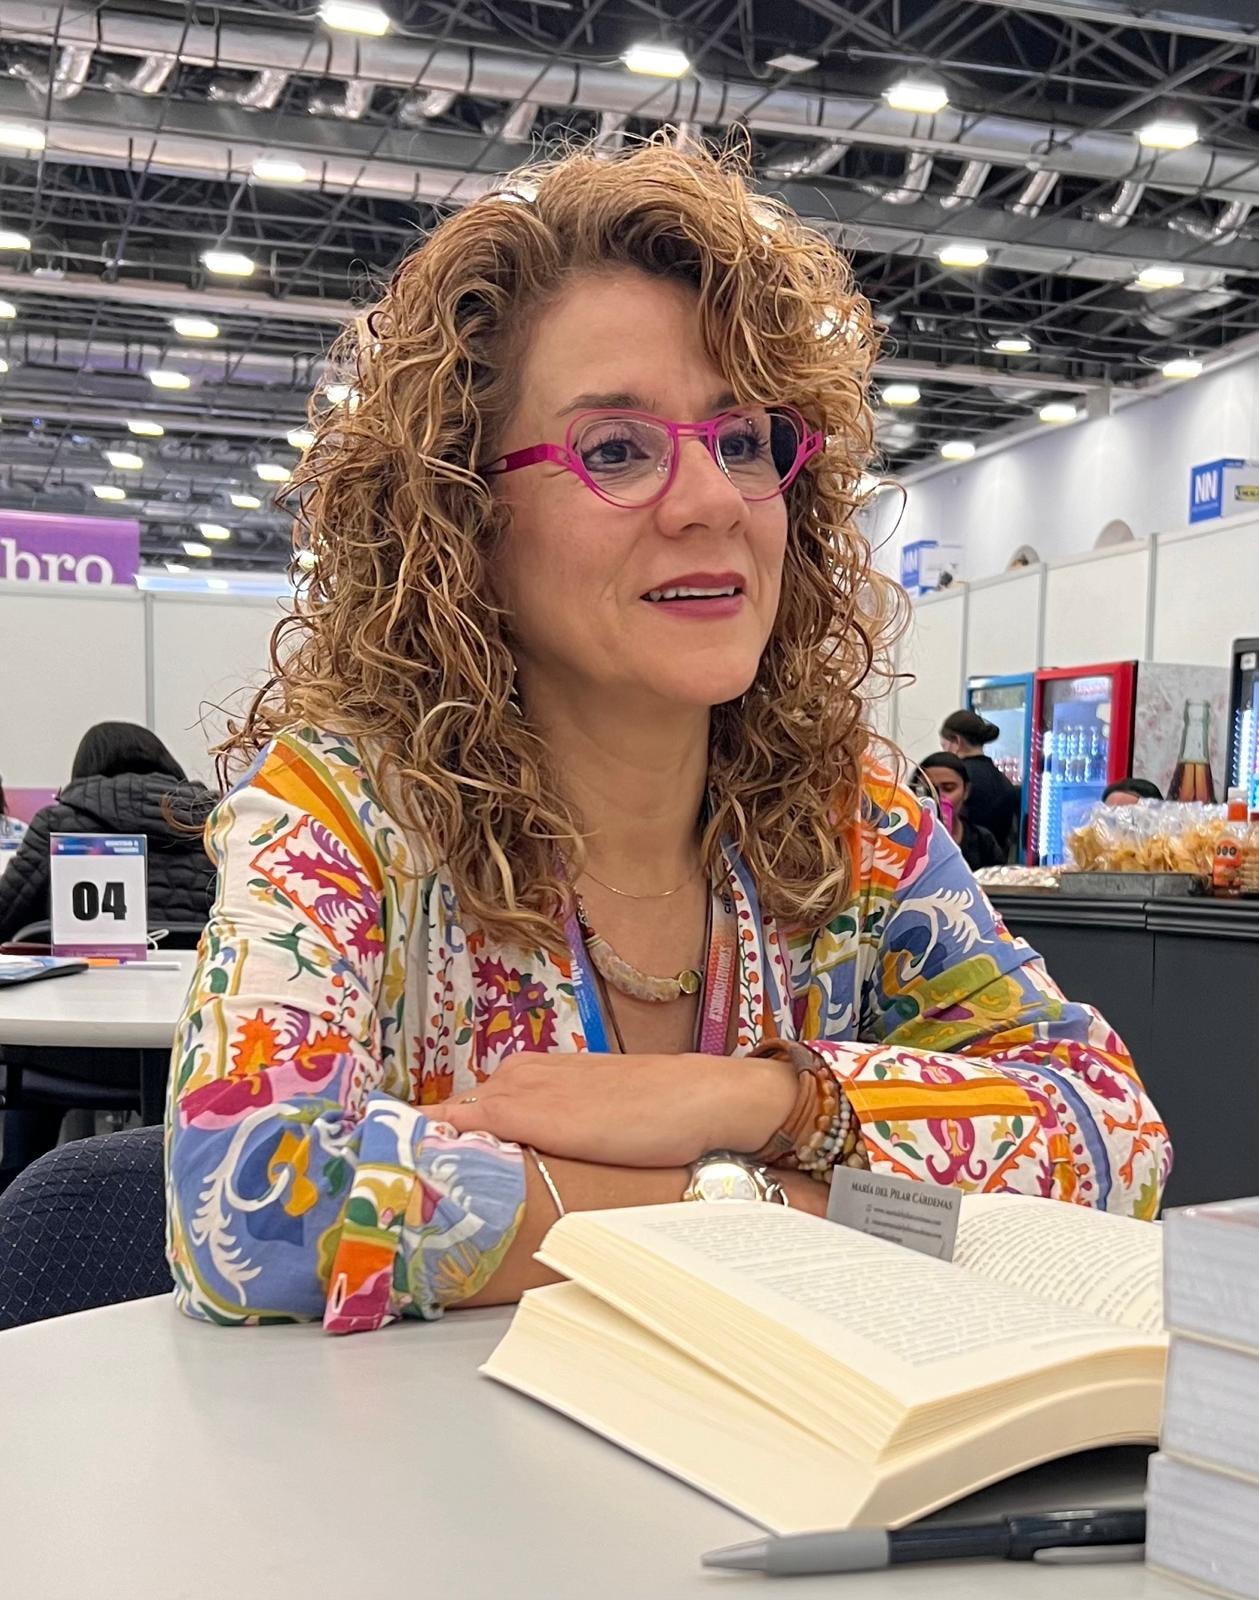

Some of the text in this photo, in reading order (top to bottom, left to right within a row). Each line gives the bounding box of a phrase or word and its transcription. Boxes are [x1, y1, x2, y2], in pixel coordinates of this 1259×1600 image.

[1195, 470, 1218, 504] NN
[72, 881, 128, 921] 04
[875, 1187, 888, 1197] DEL
[889, 1187, 911, 1201] PILAR
